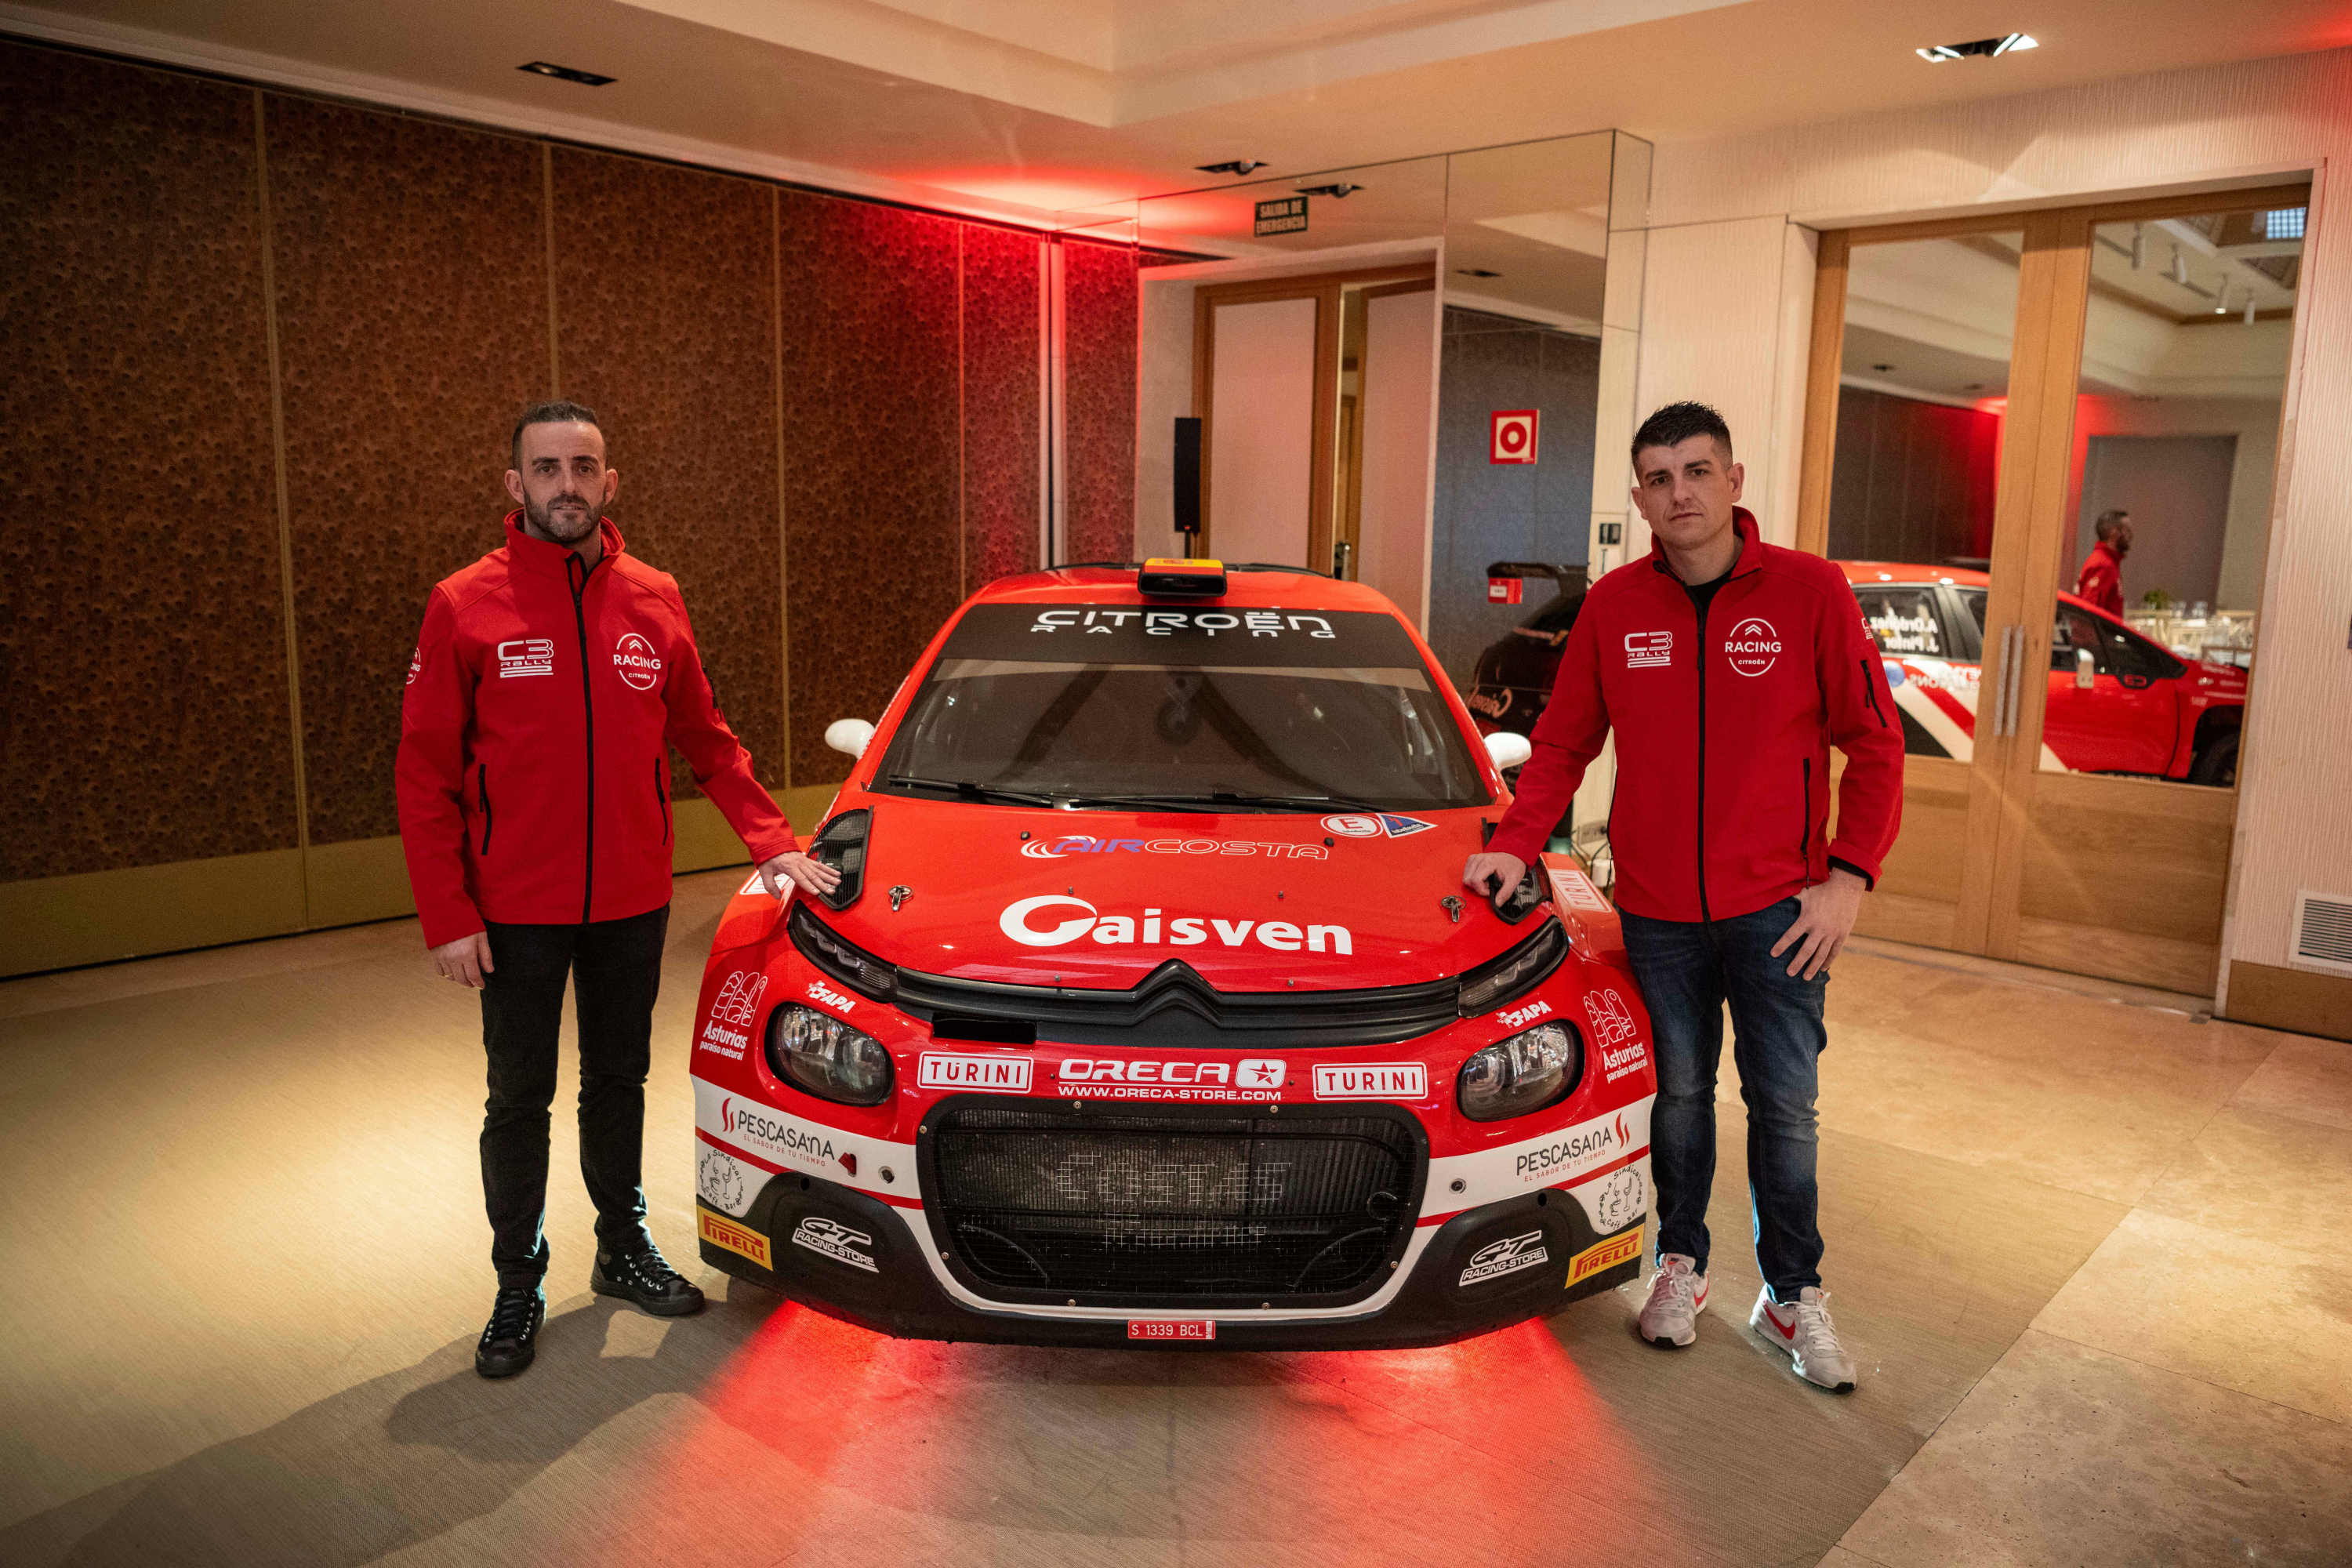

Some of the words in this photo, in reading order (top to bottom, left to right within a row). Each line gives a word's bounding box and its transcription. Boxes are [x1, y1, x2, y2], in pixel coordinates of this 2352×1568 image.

[1259, 201, 1289, 219] SALIDA
[1290, 199, 1302, 213] DE
[497, 638, 554, 661] C3
[1624, 630, 1673, 652] C3
[1725, 641, 1782, 653] RACING
[613, 654, 662, 670] RACING
[1338, 818, 1363, 829] E
[1554, 873, 1597, 906] TURINI
[702, 1019, 749, 1050] Asturias
[699, 1040, 721, 1054] paraíso
[720, 1047, 744, 1062] natural
[1602, 1042, 1645, 1071] Asturias
[931, 1062, 1022, 1086] TURINI
[1058, 1058, 1231, 1083] ORECA
[1325, 1070, 1417, 1091] TURINI
[1606, 1065, 1628, 1084] paraíso
[1628, 1055, 1648, 1073] natural
[1058, 1086, 1282, 1101] WWW.ORECA-STORE.COM
[753, 1137, 774, 1150] SABOR
[788, 1149, 797, 1158] TU
[799, 1153, 826, 1167] TIEMPO
[1536, 1166, 1559, 1179] SABOR
[1562, 1162, 1571, 1171] DE
[1573, 1158, 1581, 1167] TU
[1584, 1149, 1606, 1163] TIEMPO
[703, 1214, 765, 1261] PIRELLI
[801, 1217, 873, 1247] GT
[796, 1230, 877, 1268] RACING-STORE
[1470, 1229, 1543, 1269] GT
[1573, 1232, 1639, 1279] PIRELLI
[1462, 1248, 1545, 1282] RACING-STORE
[1131, 1324, 1139, 1336] S
[1145, 1324, 1174, 1336] 1339
[1179, 1324, 1203, 1336] BCL
